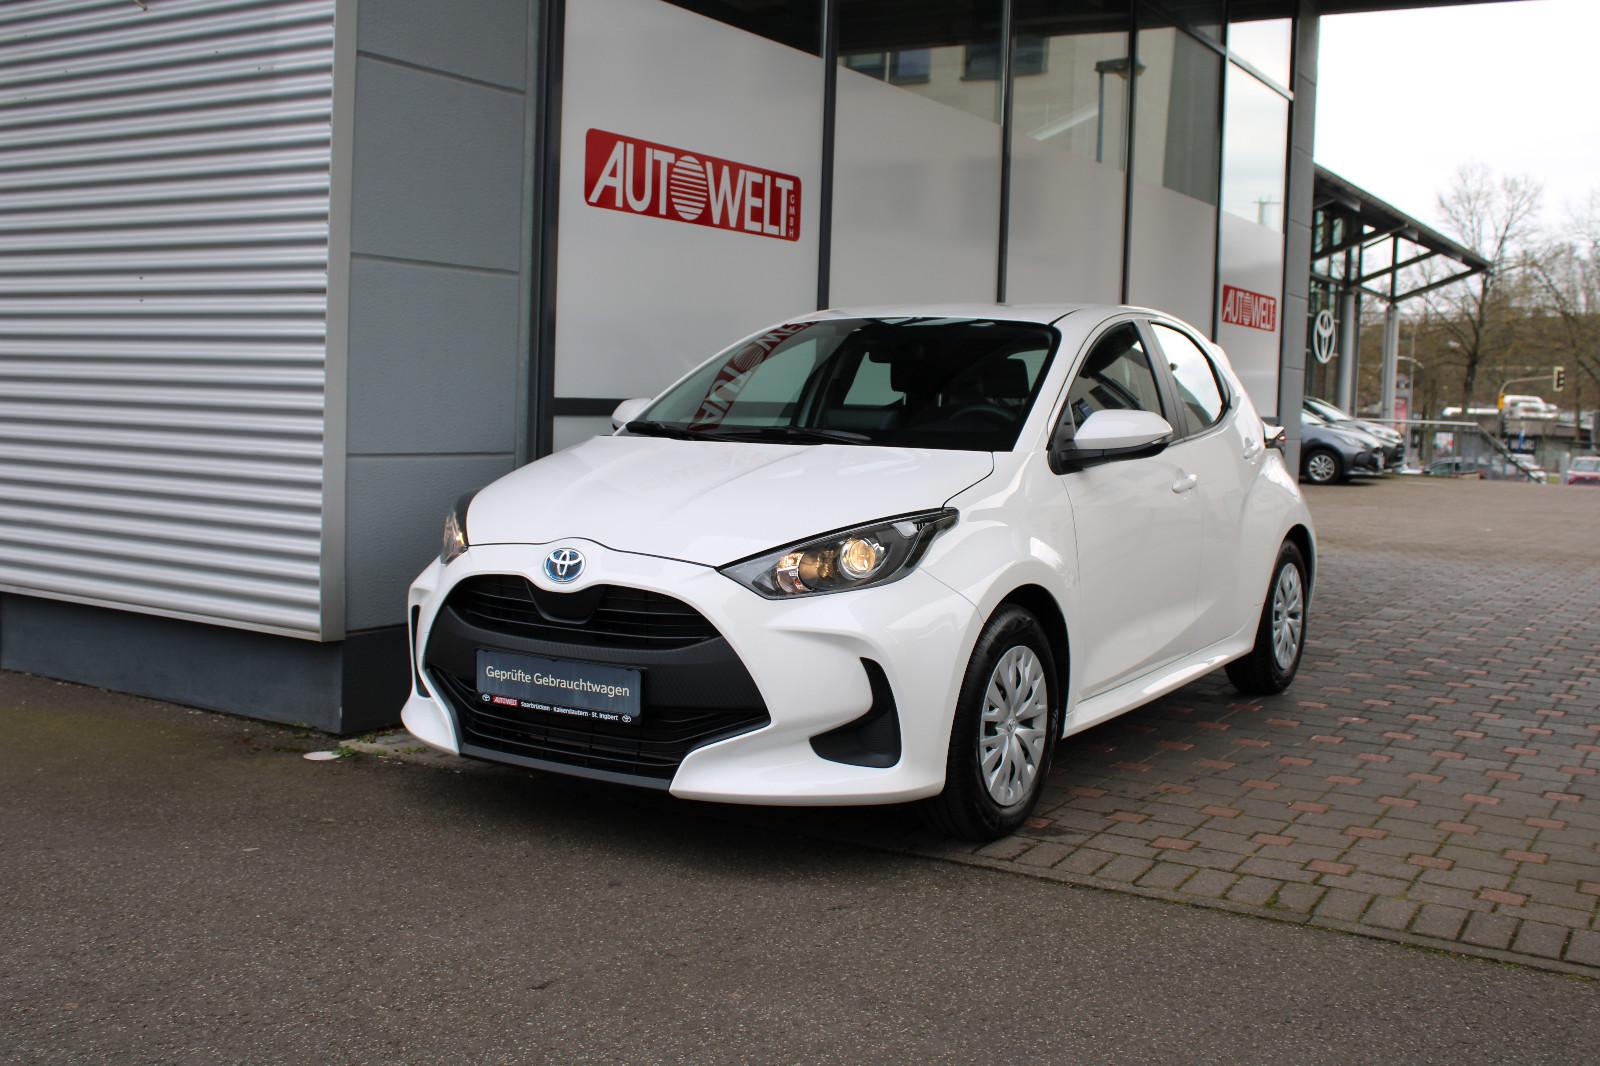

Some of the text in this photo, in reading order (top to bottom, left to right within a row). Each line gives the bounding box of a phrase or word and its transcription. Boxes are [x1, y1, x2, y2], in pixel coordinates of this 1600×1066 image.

[588, 141, 794, 237] AUTOWELT
[1222, 288, 1274, 330] AUTOWELT
[486, 665, 630, 698] Geprüfte Gebrauchtwagen
